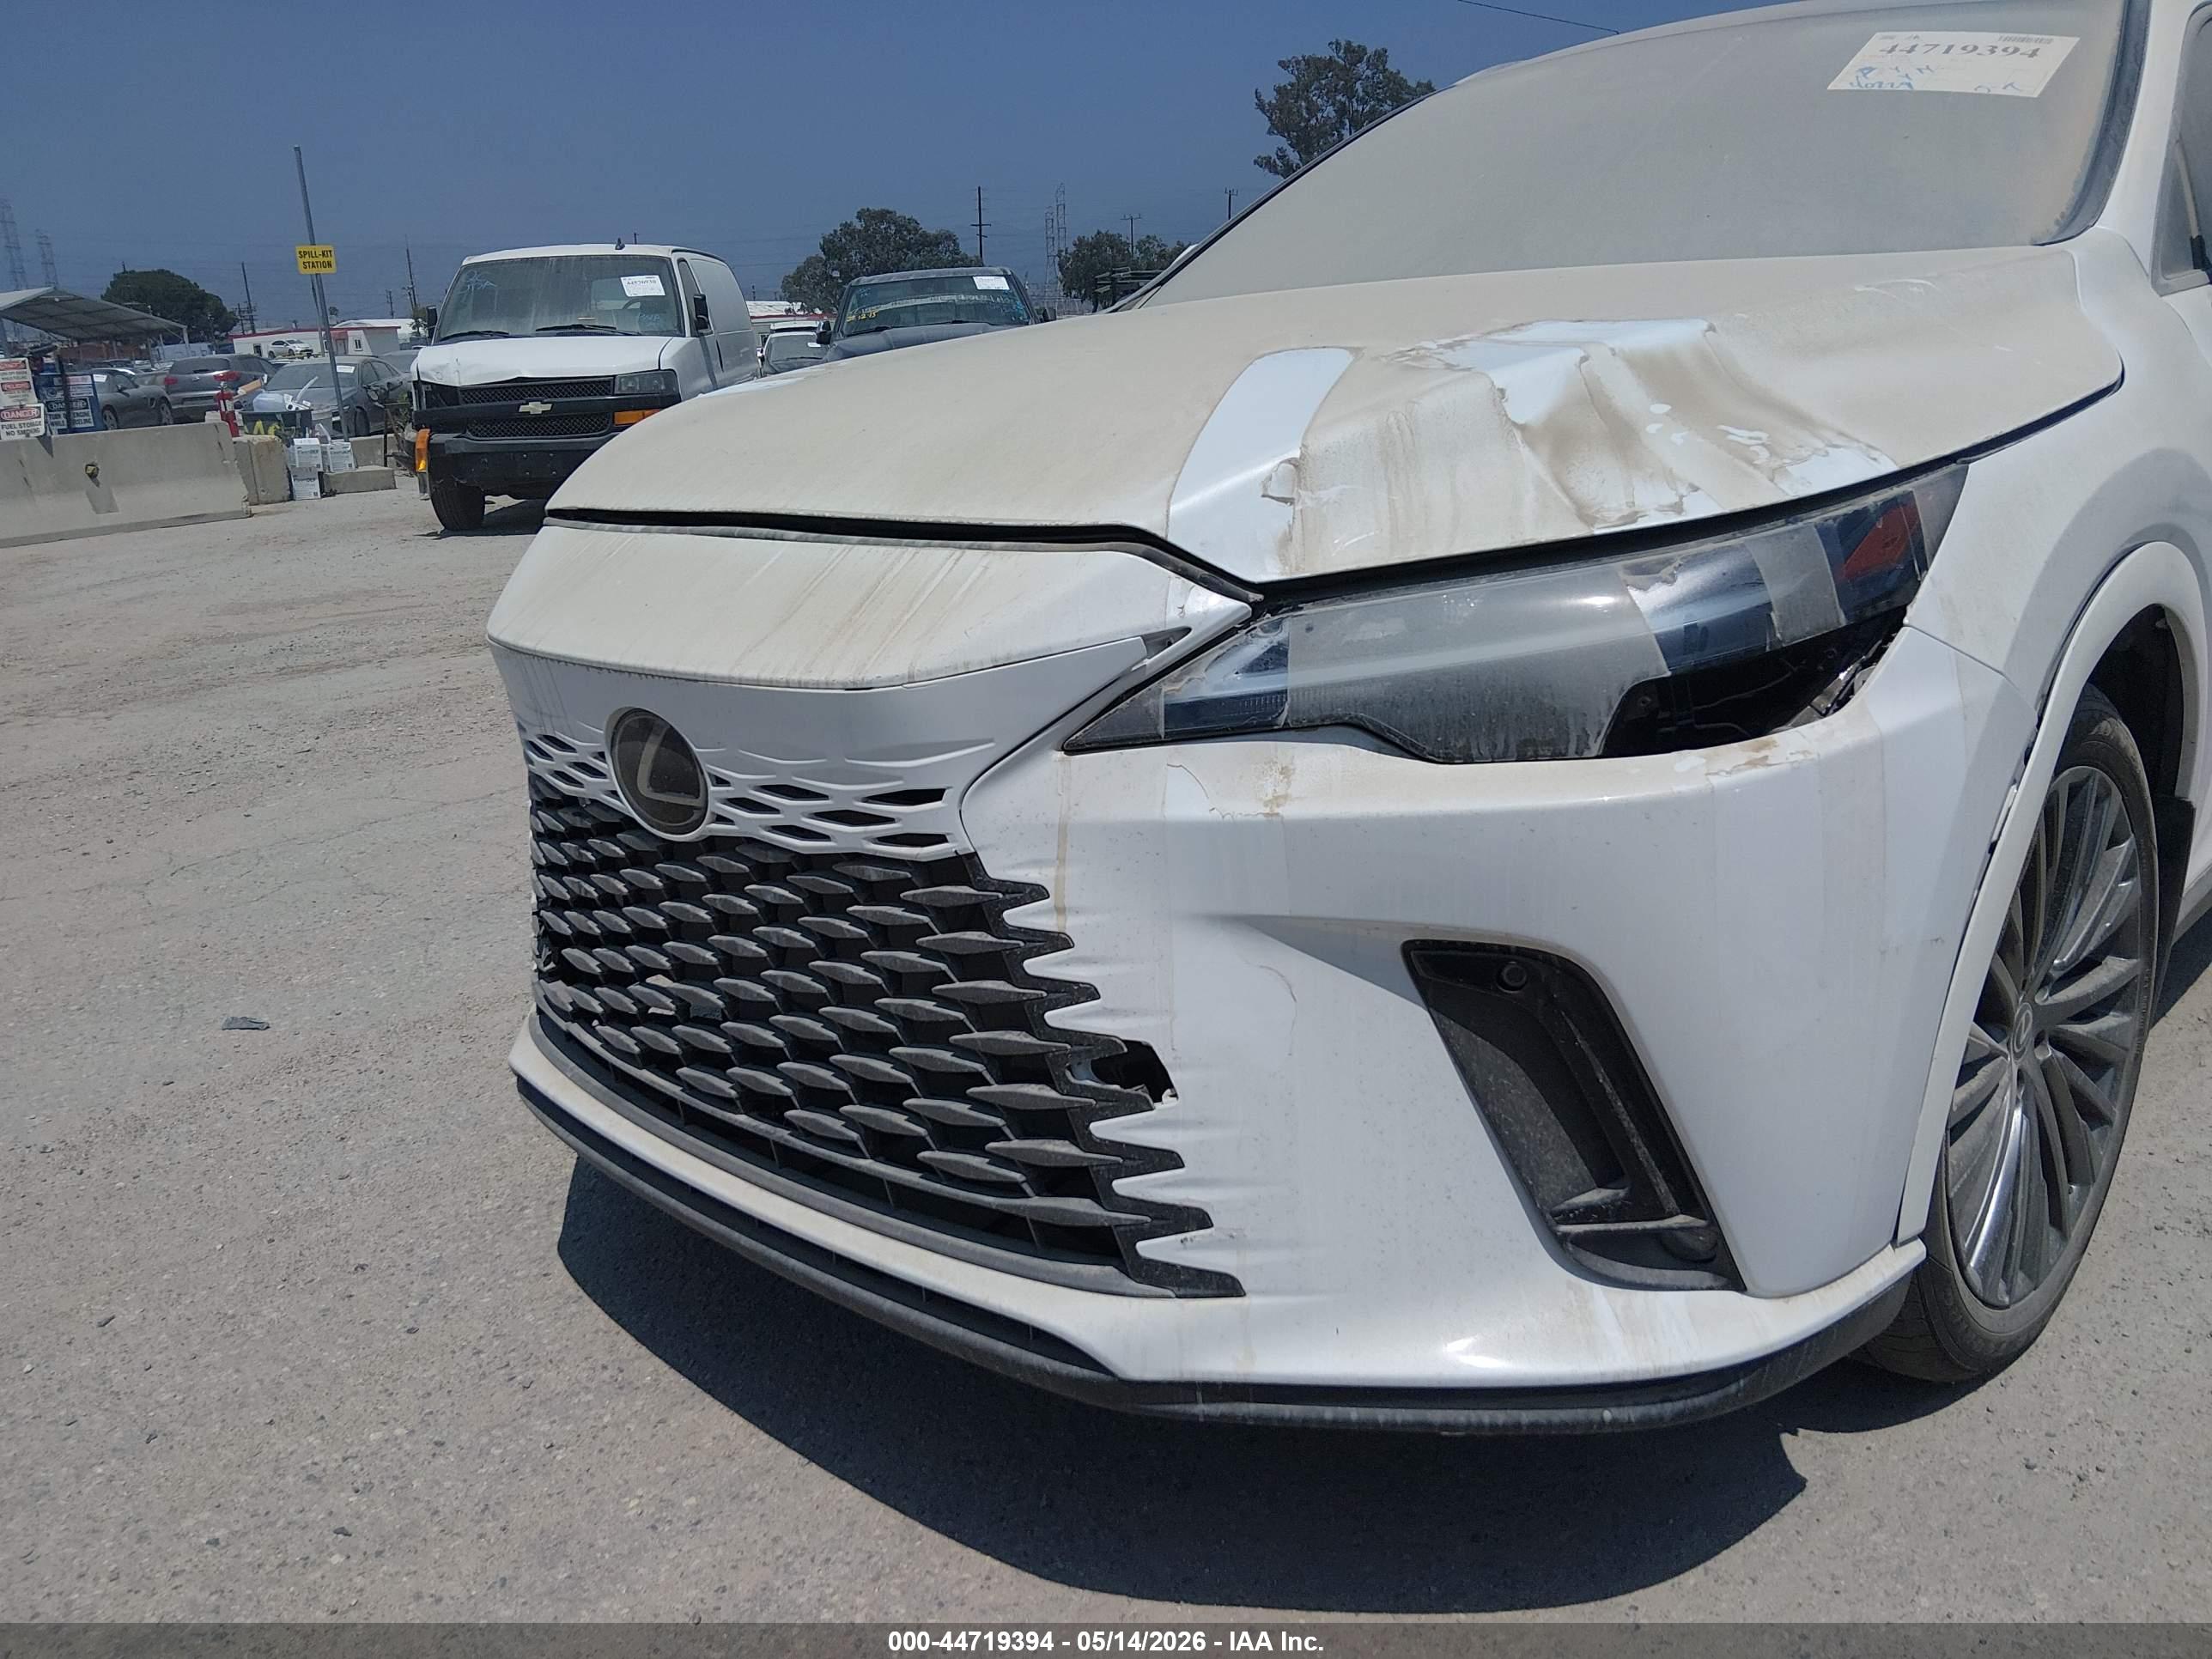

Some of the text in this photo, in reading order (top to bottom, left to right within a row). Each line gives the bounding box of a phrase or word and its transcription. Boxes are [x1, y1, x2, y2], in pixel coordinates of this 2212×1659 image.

[1879, 43, 2040, 58] 44719394
[298, 250, 332, 258] SPILL-KIT
[302, 260, 332, 269] STATION
[4, 409, 37, 419] DANGER
